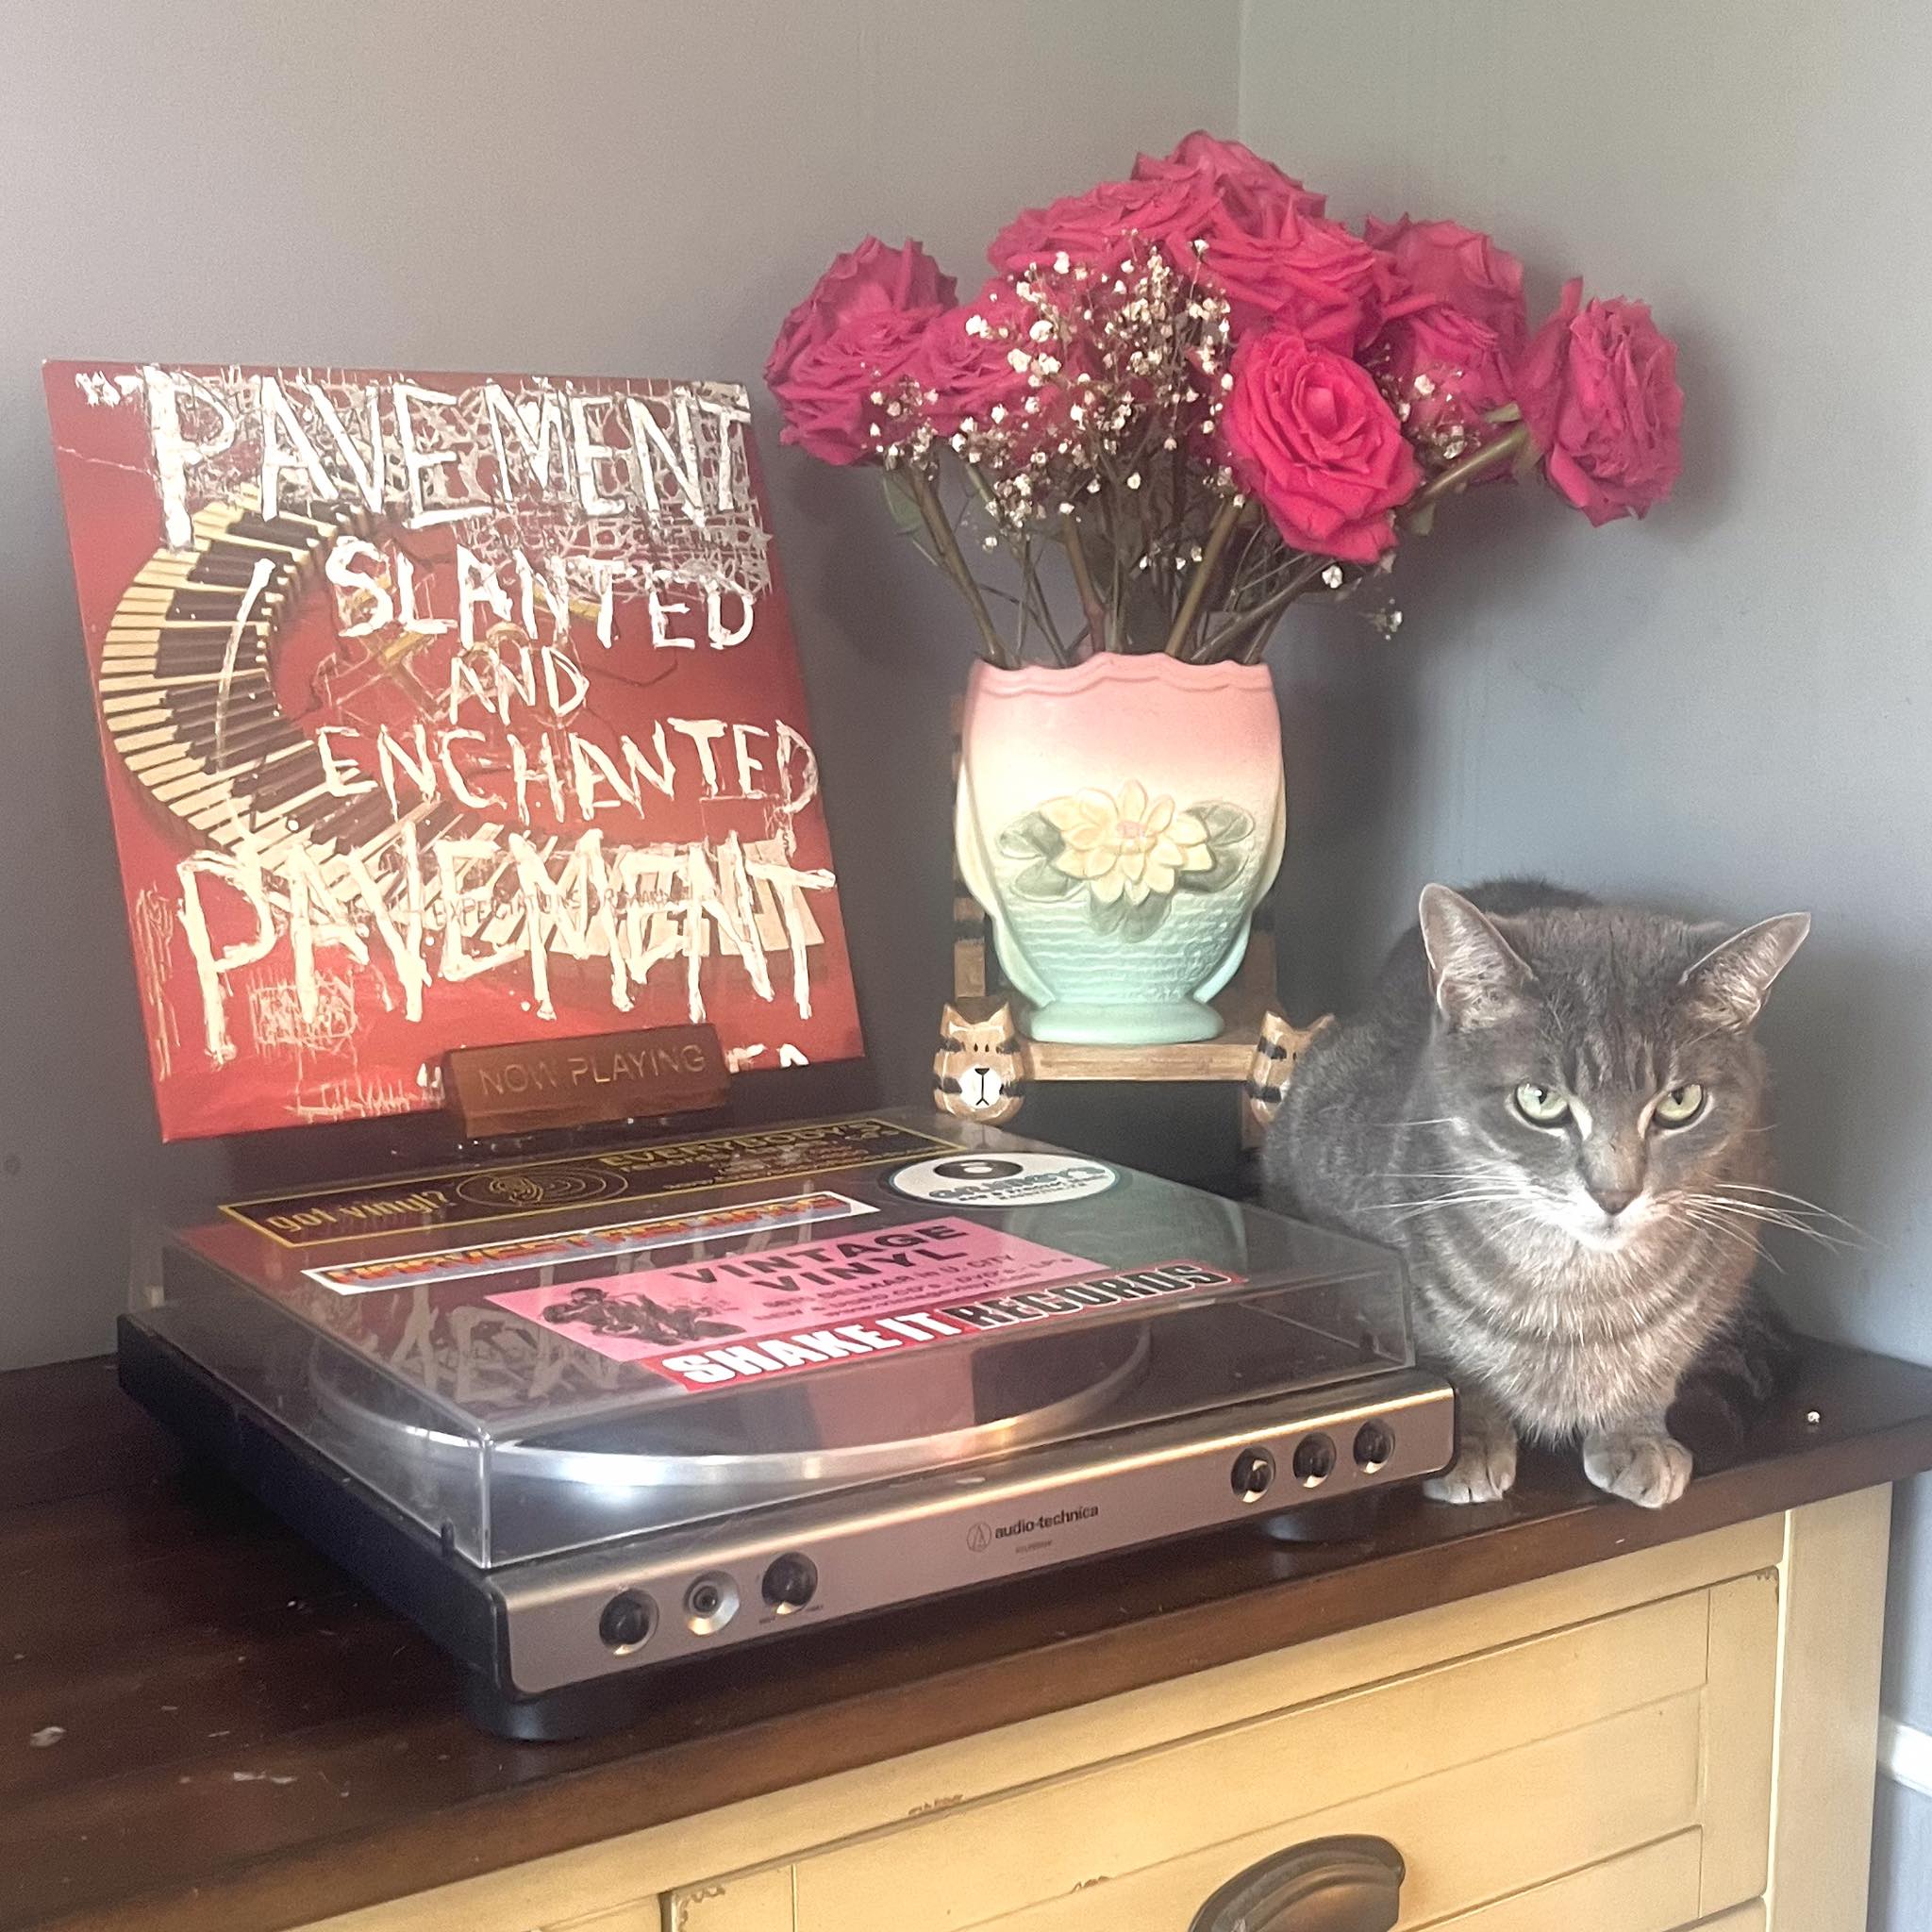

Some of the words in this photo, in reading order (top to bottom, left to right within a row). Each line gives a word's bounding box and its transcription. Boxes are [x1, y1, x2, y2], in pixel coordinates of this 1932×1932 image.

[142, 363, 753, 553] PAVEMENT
[325, 535, 757, 649] SLANTED
[448, 641, 591, 724] AND
[317, 718, 819, 826] ENCHANTED
[176, 821, 838, 1065] PAVEMENT
[479, 1061, 558, 1096] NOW
[569, 1043, 706, 1086] PLAYING
[266, 1205, 337, 1234] got
[339, 1190, 452, 1223] vinyl?
[673, 1225, 970, 1284] VINTAGE
[749, 1248, 968, 1292] VINYL
[661, 1323, 904, 1384] SHAKE
[874, 1311, 963, 1343] IT
[940, 1265, 1231, 1331] RECORDS
[994, 1505, 1100, 1540] audio-technica
